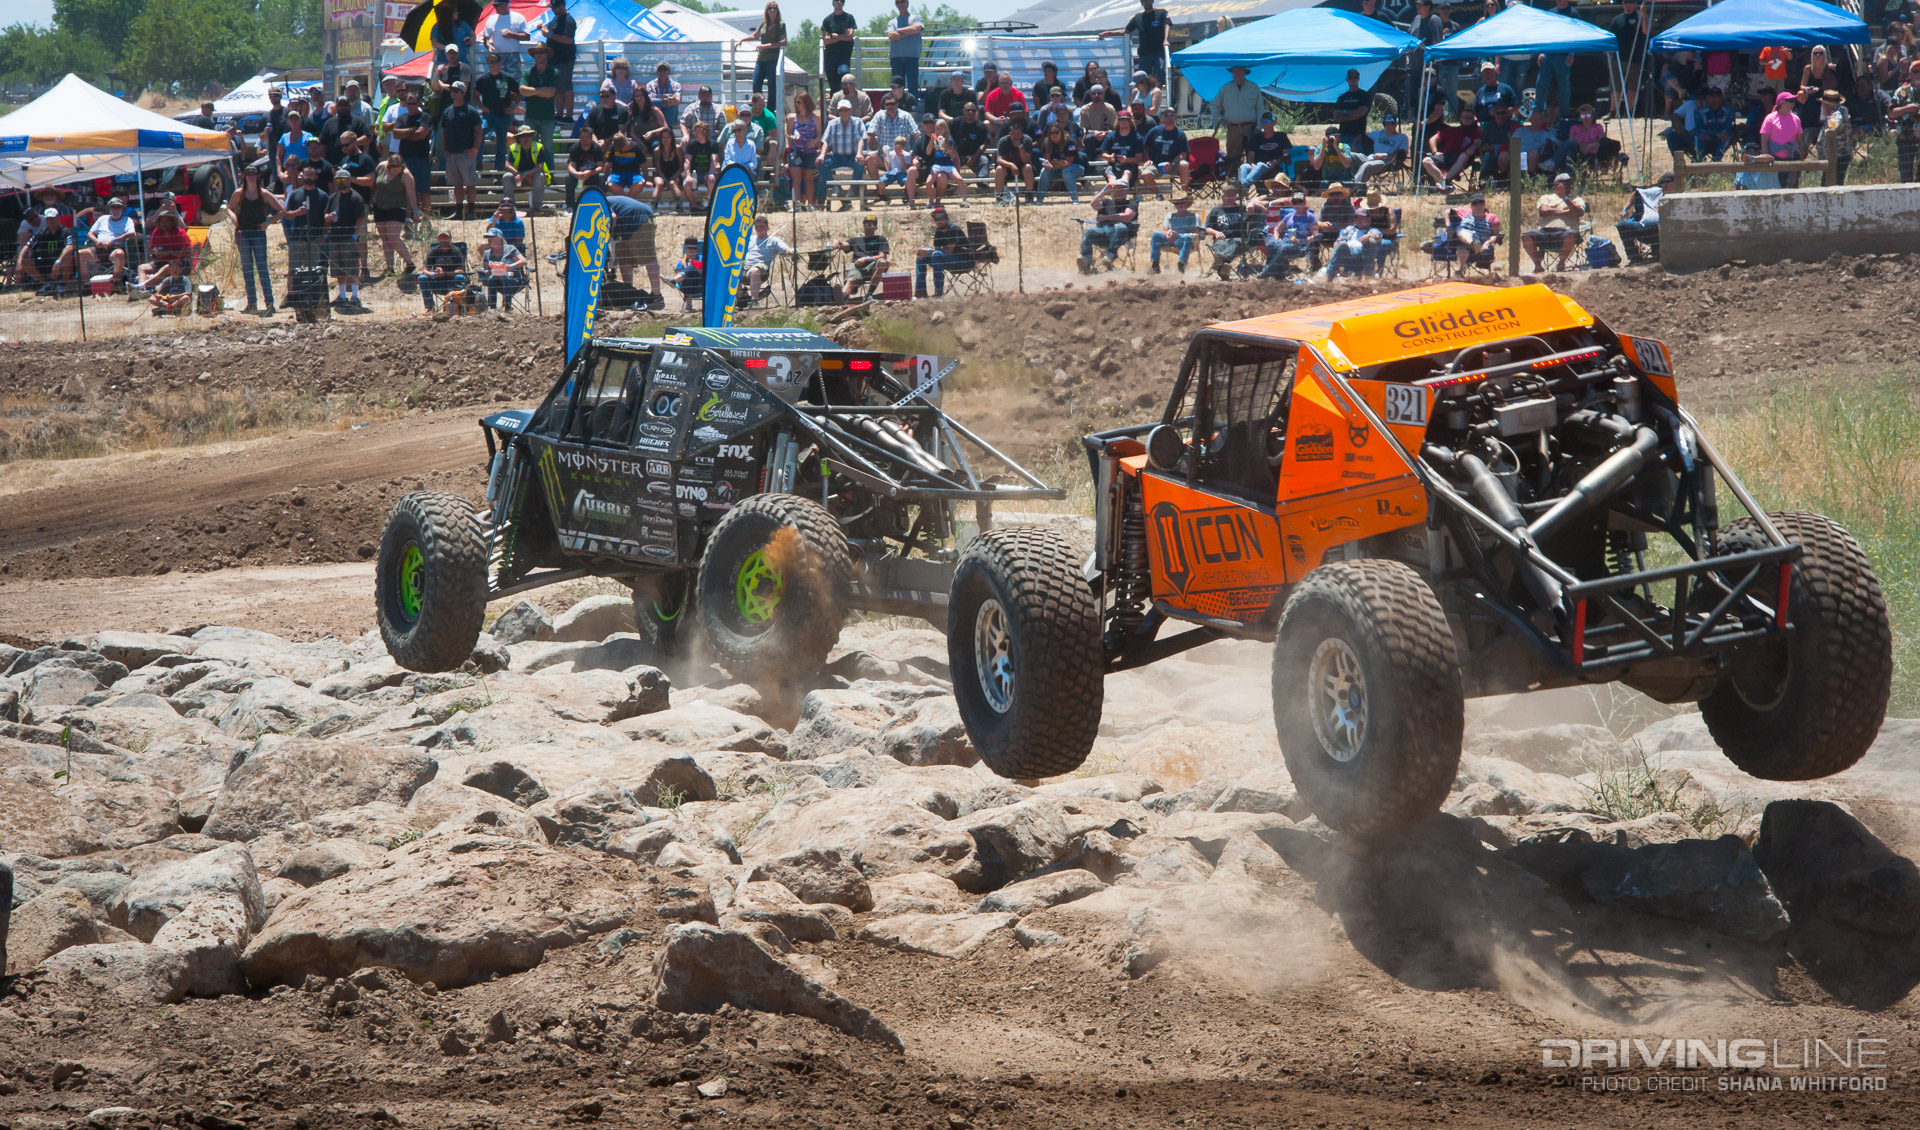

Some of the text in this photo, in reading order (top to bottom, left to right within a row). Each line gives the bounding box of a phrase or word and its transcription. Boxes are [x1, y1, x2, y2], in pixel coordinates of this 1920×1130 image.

[1393, 306, 1516, 338] Glidden
[1401, 319, 1521, 349] CONSTRUCTION
[1634, 340, 1670, 374] 321
[766, 354, 792, 391] 3
[920, 359, 932, 395] 3
[1386, 385, 1425, 423] 321
[639, 437, 671, 449] HUGHES
[717, 444, 754, 462] FOX
[1296, 444, 1333, 455] Glidden
[558, 451, 644, 479] MONSTER
[571, 472, 631, 487] ENERGY
[1187, 512, 1264, 565] ICON
[1230, 566, 1271, 581] DYNAMICS
